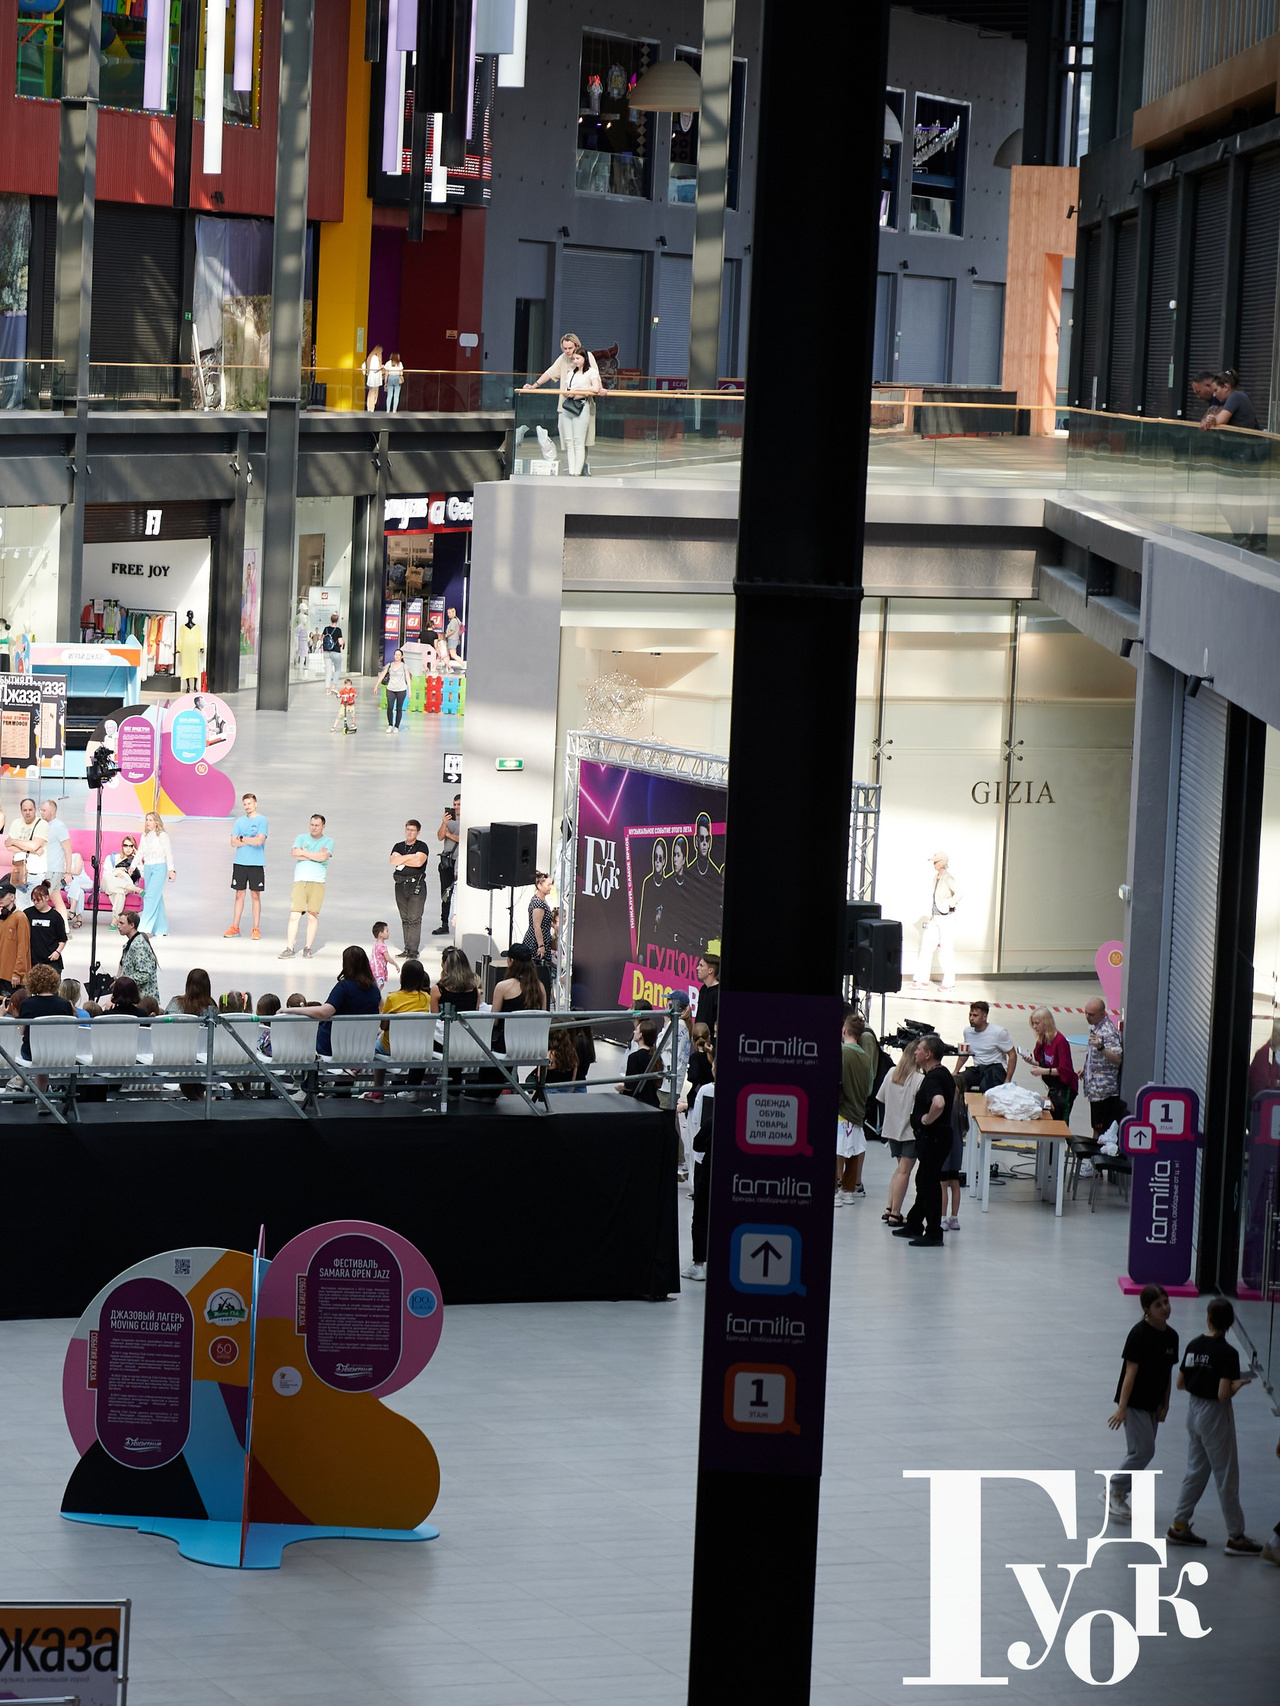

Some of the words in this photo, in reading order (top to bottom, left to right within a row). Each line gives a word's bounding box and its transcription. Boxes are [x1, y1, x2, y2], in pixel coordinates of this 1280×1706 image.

[111, 562, 144, 576] FREE
[147, 564, 170, 578] JOY
[971, 780, 1056, 805] GIZIA
[738, 1033, 818, 1058] familia
[755, 1099, 791, 1108] ОДЕЖДА
[758, 1109, 786, 1118] ОБУВЬ
[1160, 1103, 1173, 1123] 1
[755, 1120, 788, 1129] ТОВАРЫ
[749, 1131, 767, 1140] ДЛЯ
[768, 1131, 793, 1140] ДОМА
[732, 1174, 812, 1197] familia
[1146, 1160, 1171, 1244] familia
[333, 1258, 379, 1269] ФЕСТИВАЛЬ
[319, 1268, 350, 1278] SAMARA
[351, 1268, 371, 1278] OPEN
[373, 1269, 390, 1279] JAZZ
[299, 1277, 307, 1303] СОБЫТИЯ
[110, 1309, 155, 1321] ДЖАЗОВЫЙ
[156, 1312, 185, 1322] ЛАГЕРЬ
[298, 1304, 306, 1326] ДЖАЗА
[110, 1320, 139, 1330] MOVING
[140, 1321, 159, 1331] CLUB
[160, 1322, 182, 1332] CAMP
[726, 1313, 806, 1337] familia
[90, 1332, 98, 1357] СОБЫТИЯ
[750, 1378, 768, 1408] 1
[748, 1411, 769, 1419] ЭТАЖ
